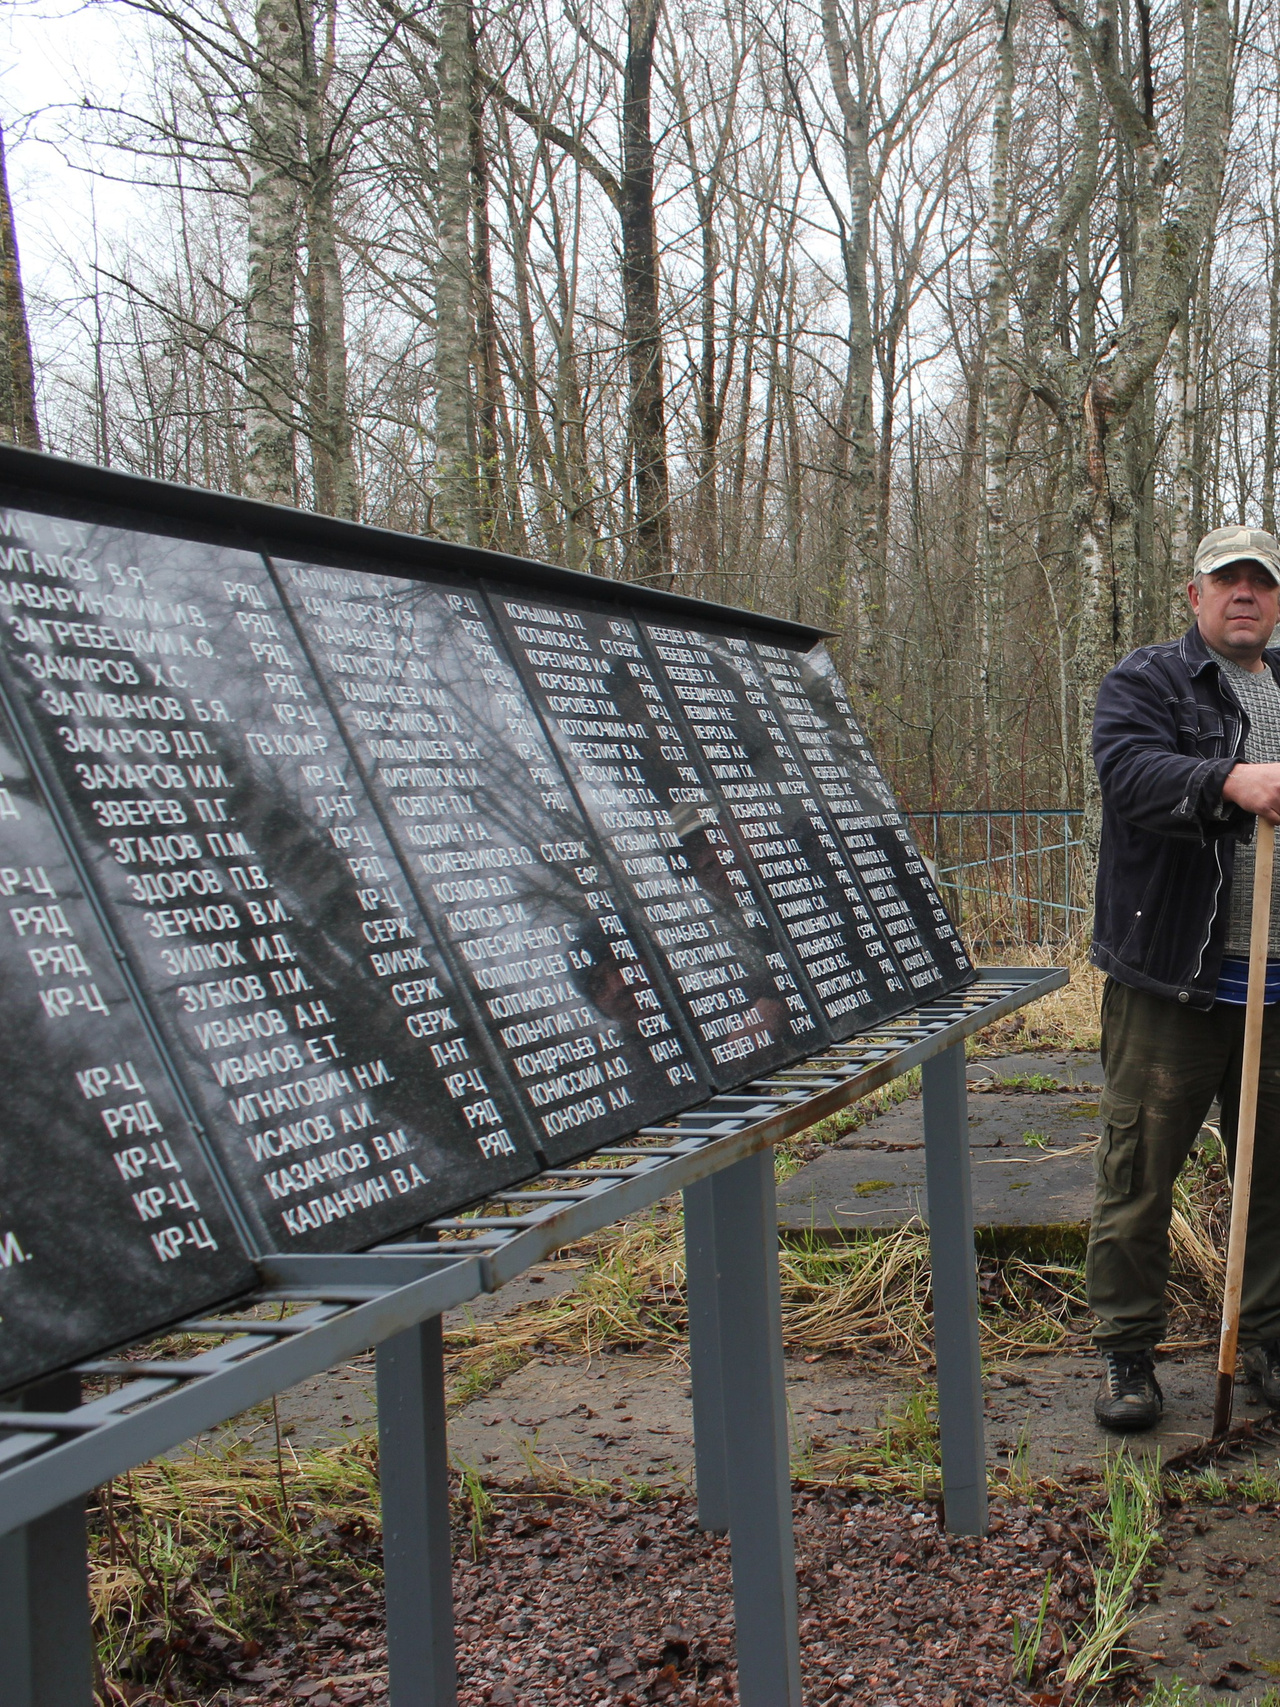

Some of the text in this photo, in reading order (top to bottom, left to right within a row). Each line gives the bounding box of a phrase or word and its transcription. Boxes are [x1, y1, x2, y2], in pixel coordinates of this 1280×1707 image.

[8, 615, 174, 657] ЗАГРЕБЕЦКИЙ
[514, 626, 571, 650] КОПЫЛОВ
[600, 639, 643, 659] СТ.СЕРЖ
[25, 652, 140, 685] ЗАКИРОВ
[263, 672, 308, 699] РЯД
[41, 689, 186, 721] ЗАЛИВАНОВ
[272, 702, 321, 728] КР-Ц
[546, 695, 598, 715] КОРОЛЁВ
[646, 705, 673, 722] КР-Ц
[59, 726, 171, 754] ЗАХАРОВ
[75, 763, 187, 790] ЗАХАРОВ
[300, 765, 348, 791] КР-Ц
[578, 766, 622, 782] КРОХИН
[677, 766, 701, 783] РЯД
[92, 798, 188, 828] ЗВЕРЕВ
[315, 795, 358, 818] Л-НТ
[109, 833, 202, 866] ЗГАДОВ
[419, 848, 511, 875] КОЖЕВНИКОВ
[539, 841, 591, 863] СТ.СЕРЖ
[127, 869, 223, 904] ЗДОРОВ
[433, 878, 489, 904] КОЗЛОВ
[574, 866, 598, 885] ЕФР
[10, 905, 74, 937] РЯД
[143, 903, 241, 939] ЗЕРНОВ
[362, 916, 416, 945] СЕРЖ
[459, 925, 562, 963] КОЛЕСНИЧЕНКО
[598, 915, 626, 935] РЯД
[28, 945, 92, 977] РЯД
[39, 983, 110, 1018] КР-Ц
[513, 1037, 596, 1078] КОНДРАТЬЕВ
[637, 1013, 672, 1039] СЕРЖ
[76, 1061, 146, 1099] КР-Ц
[229, 1069, 354, 1125] ИГНАТОВИЧ
[527, 1062, 605, 1108] КОНИССКИЙ
[541, 1096, 606, 1138] КОНОНОВ
[666, 1062, 696, 1087] КР-Ц
[101, 1101, 163, 1138] РЯД
[246, 1114, 335, 1163] ИСАКОВ
[113, 1139, 182, 1180] КР-Ц
[263, 1142, 371, 1200] КАЗАЧКОВ
[132, 1179, 199, 1221] КР-Ц
[281, 1175, 393, 1236] КАЛАНЧИН
[151, 1219, 218, 1262] КР-Ц
